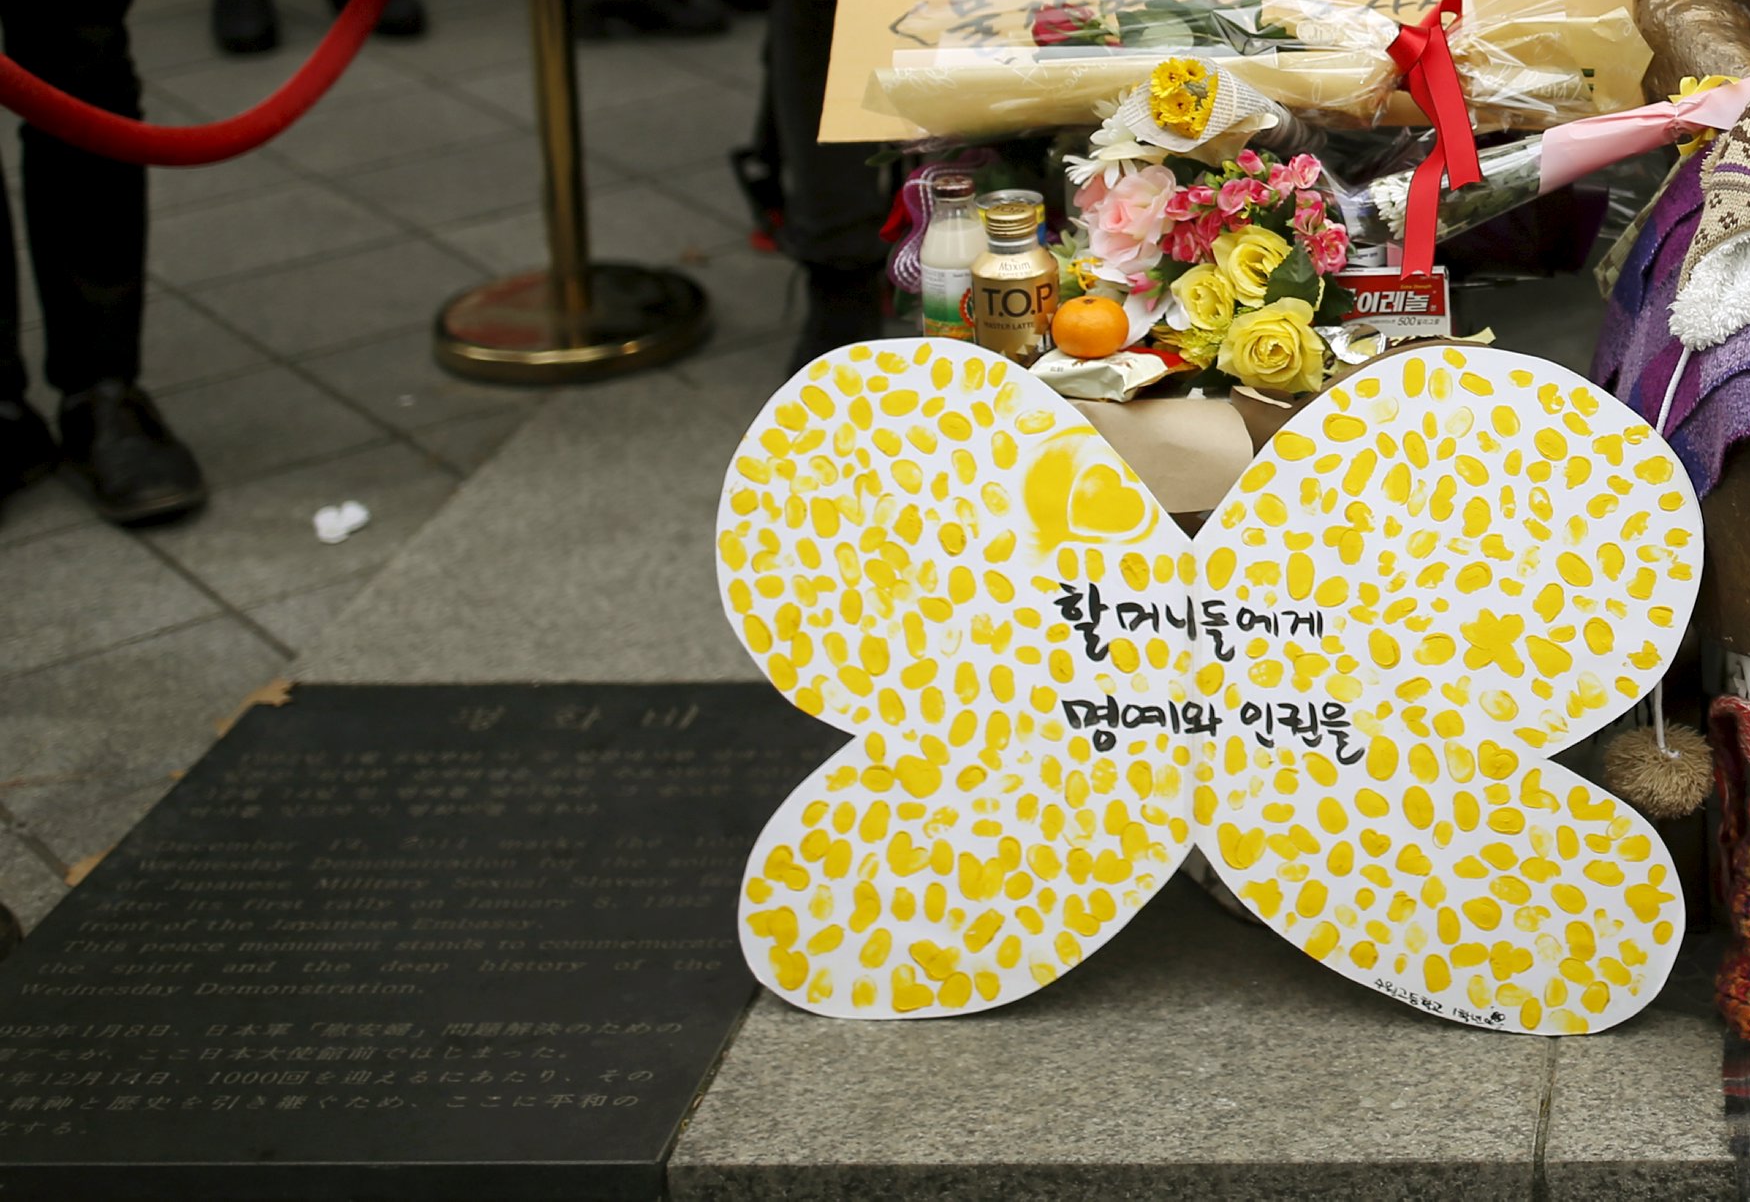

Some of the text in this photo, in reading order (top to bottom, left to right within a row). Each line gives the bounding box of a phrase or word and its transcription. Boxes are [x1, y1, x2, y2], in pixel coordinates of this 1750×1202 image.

[982, 283, 1053, 318] T.O.P
[1053, 582, 1325, 662] 할머니들에게
[1061, 697, 1368, 765] 명예와 인권을
